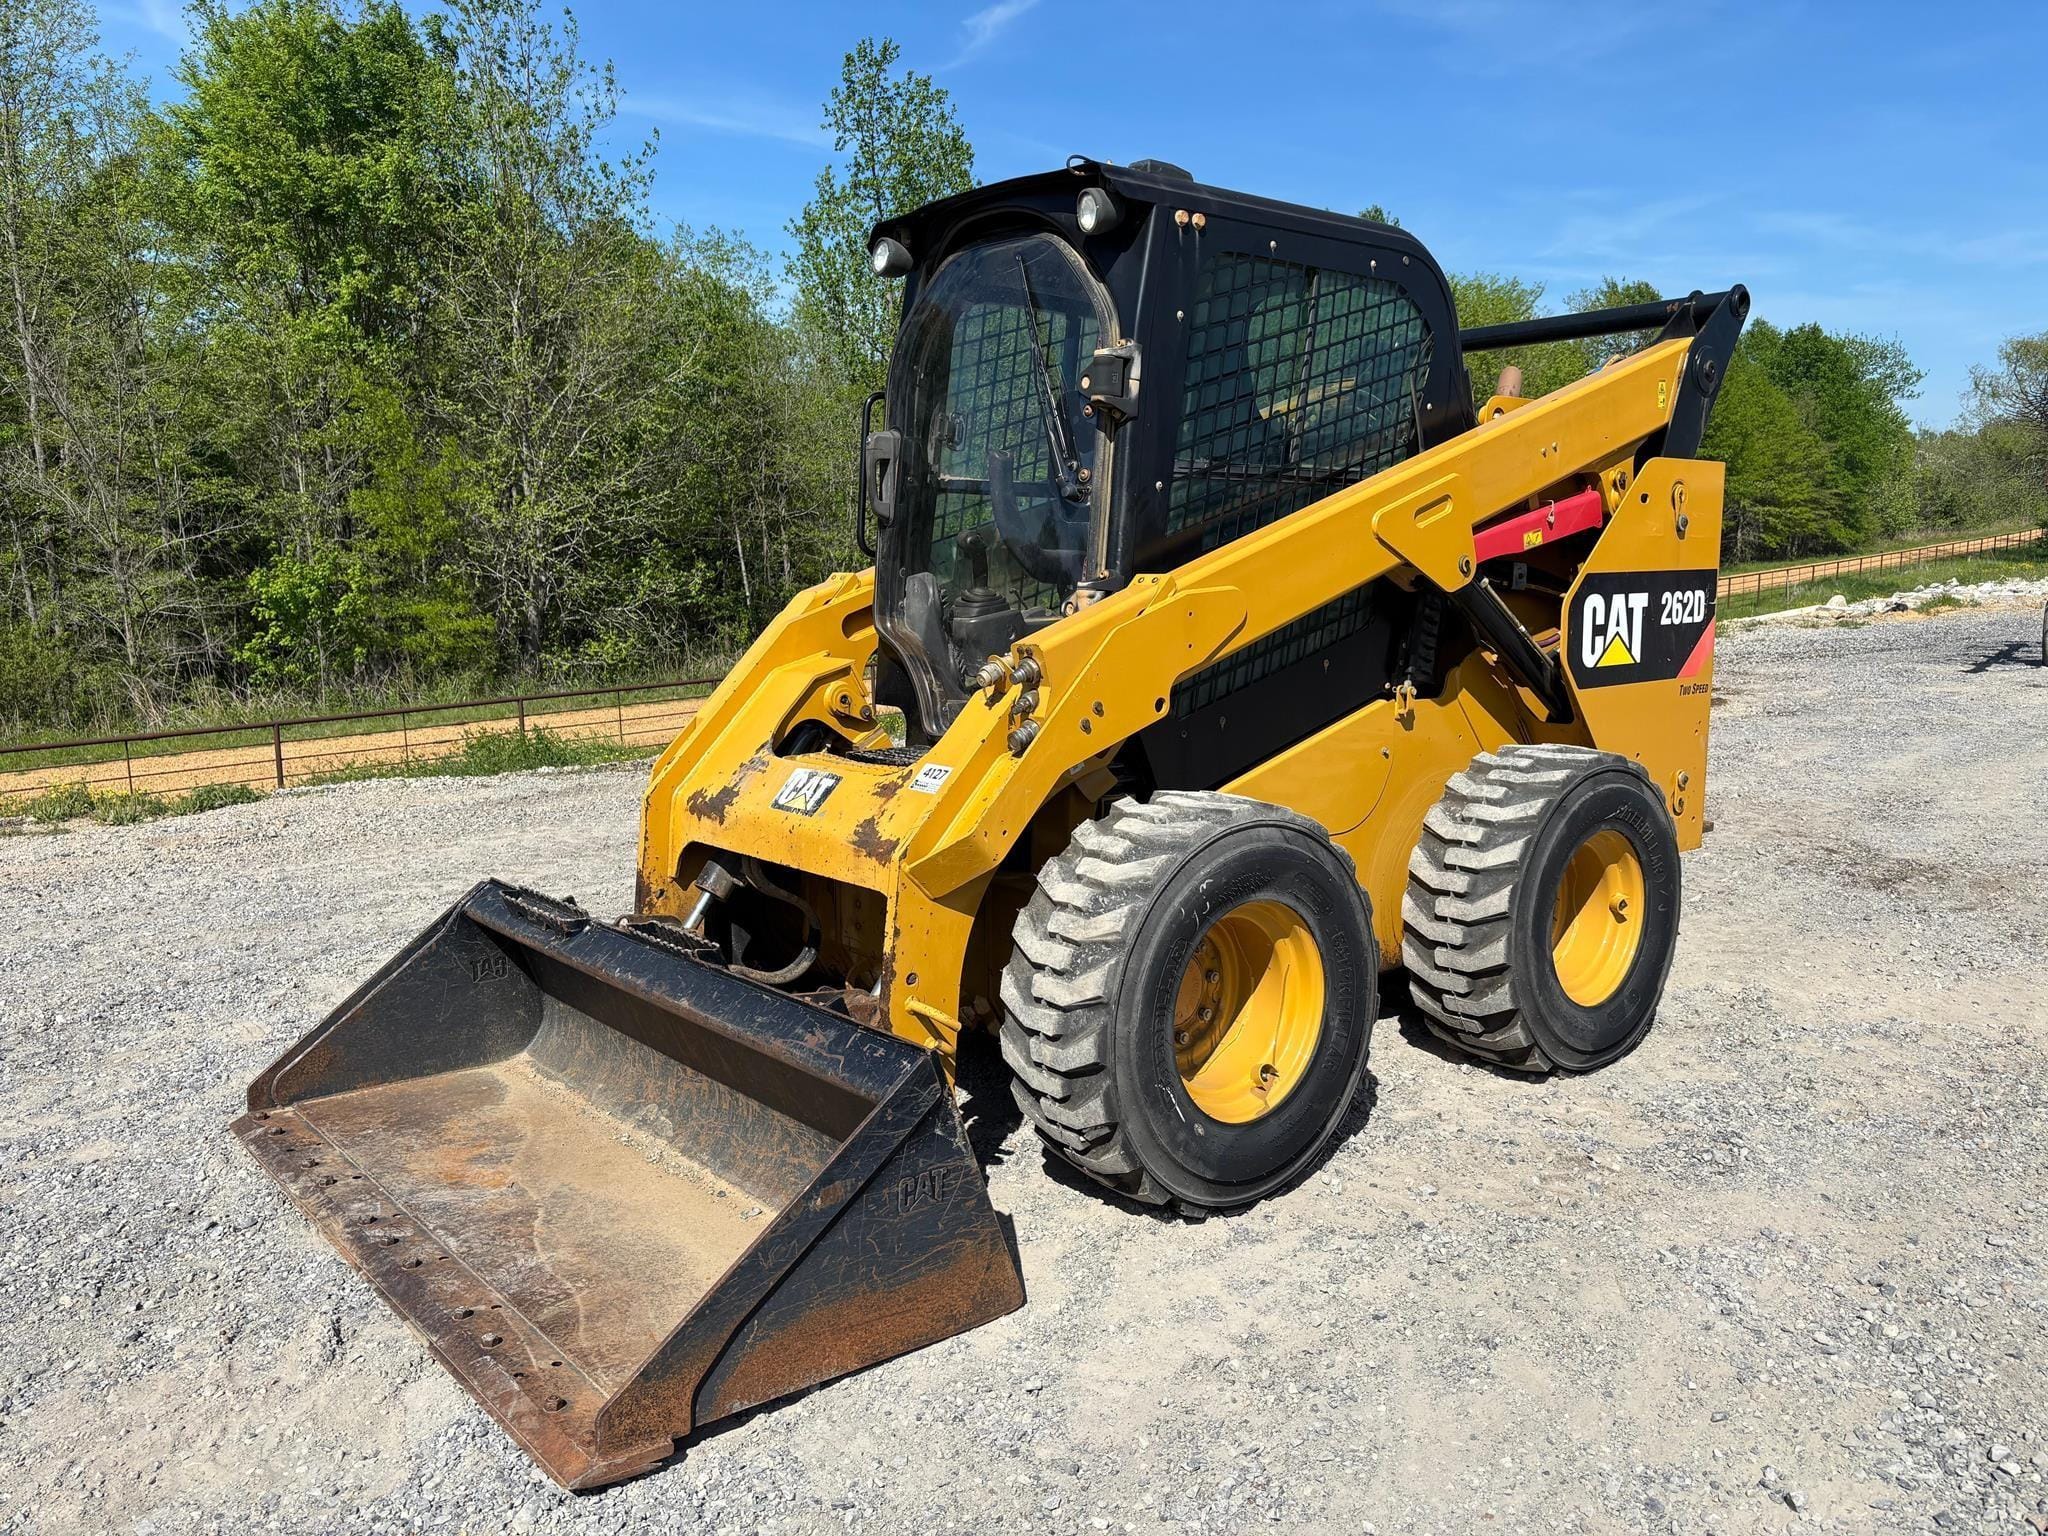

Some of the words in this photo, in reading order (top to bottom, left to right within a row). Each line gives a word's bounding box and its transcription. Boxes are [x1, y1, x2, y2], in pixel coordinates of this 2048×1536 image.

[1581, 592, 1649, 669] CAT
[1660, 590, 1705, 625] 262D
[776, 769, 836, 811] CAT
[923, 767, 949, 780] 4127
[898, 1167, 948, 1215] CAT
